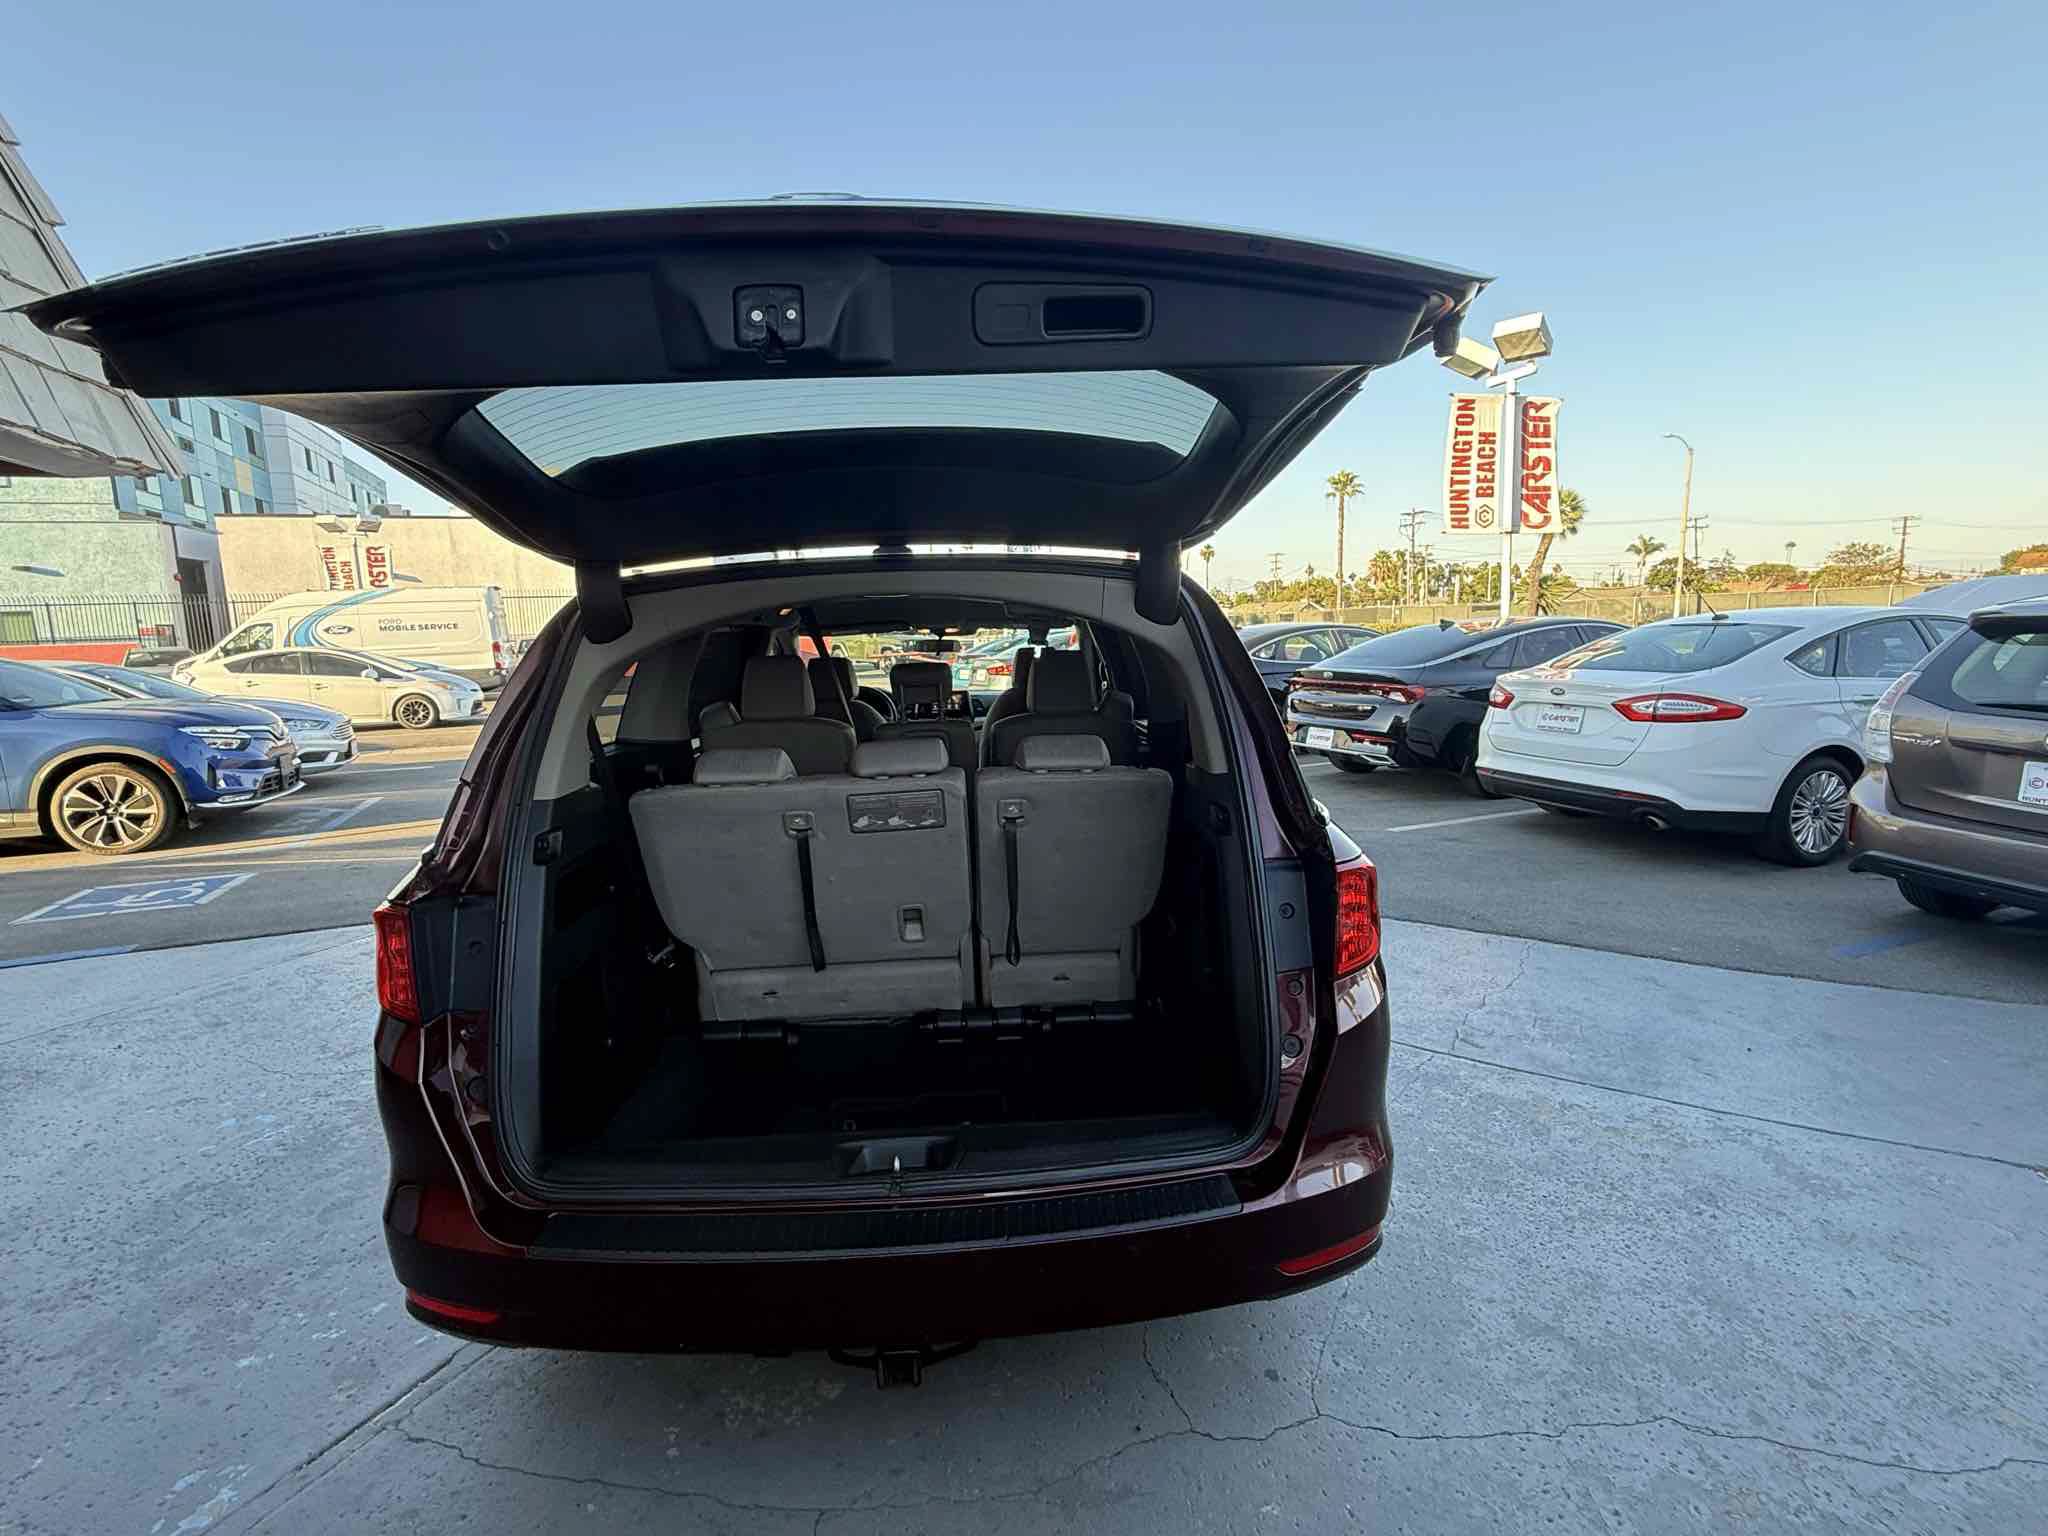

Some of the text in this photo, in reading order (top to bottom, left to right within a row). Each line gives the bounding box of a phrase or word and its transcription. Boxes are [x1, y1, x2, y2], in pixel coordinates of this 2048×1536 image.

[1449, 398, 1476, 529] HUNTINGTON
[1475, 431, 1497, 498] BEACH
[1520, 400, 1552, 529] CARSTER
[379, 622, 459, 632] MOBILE SERVICE
